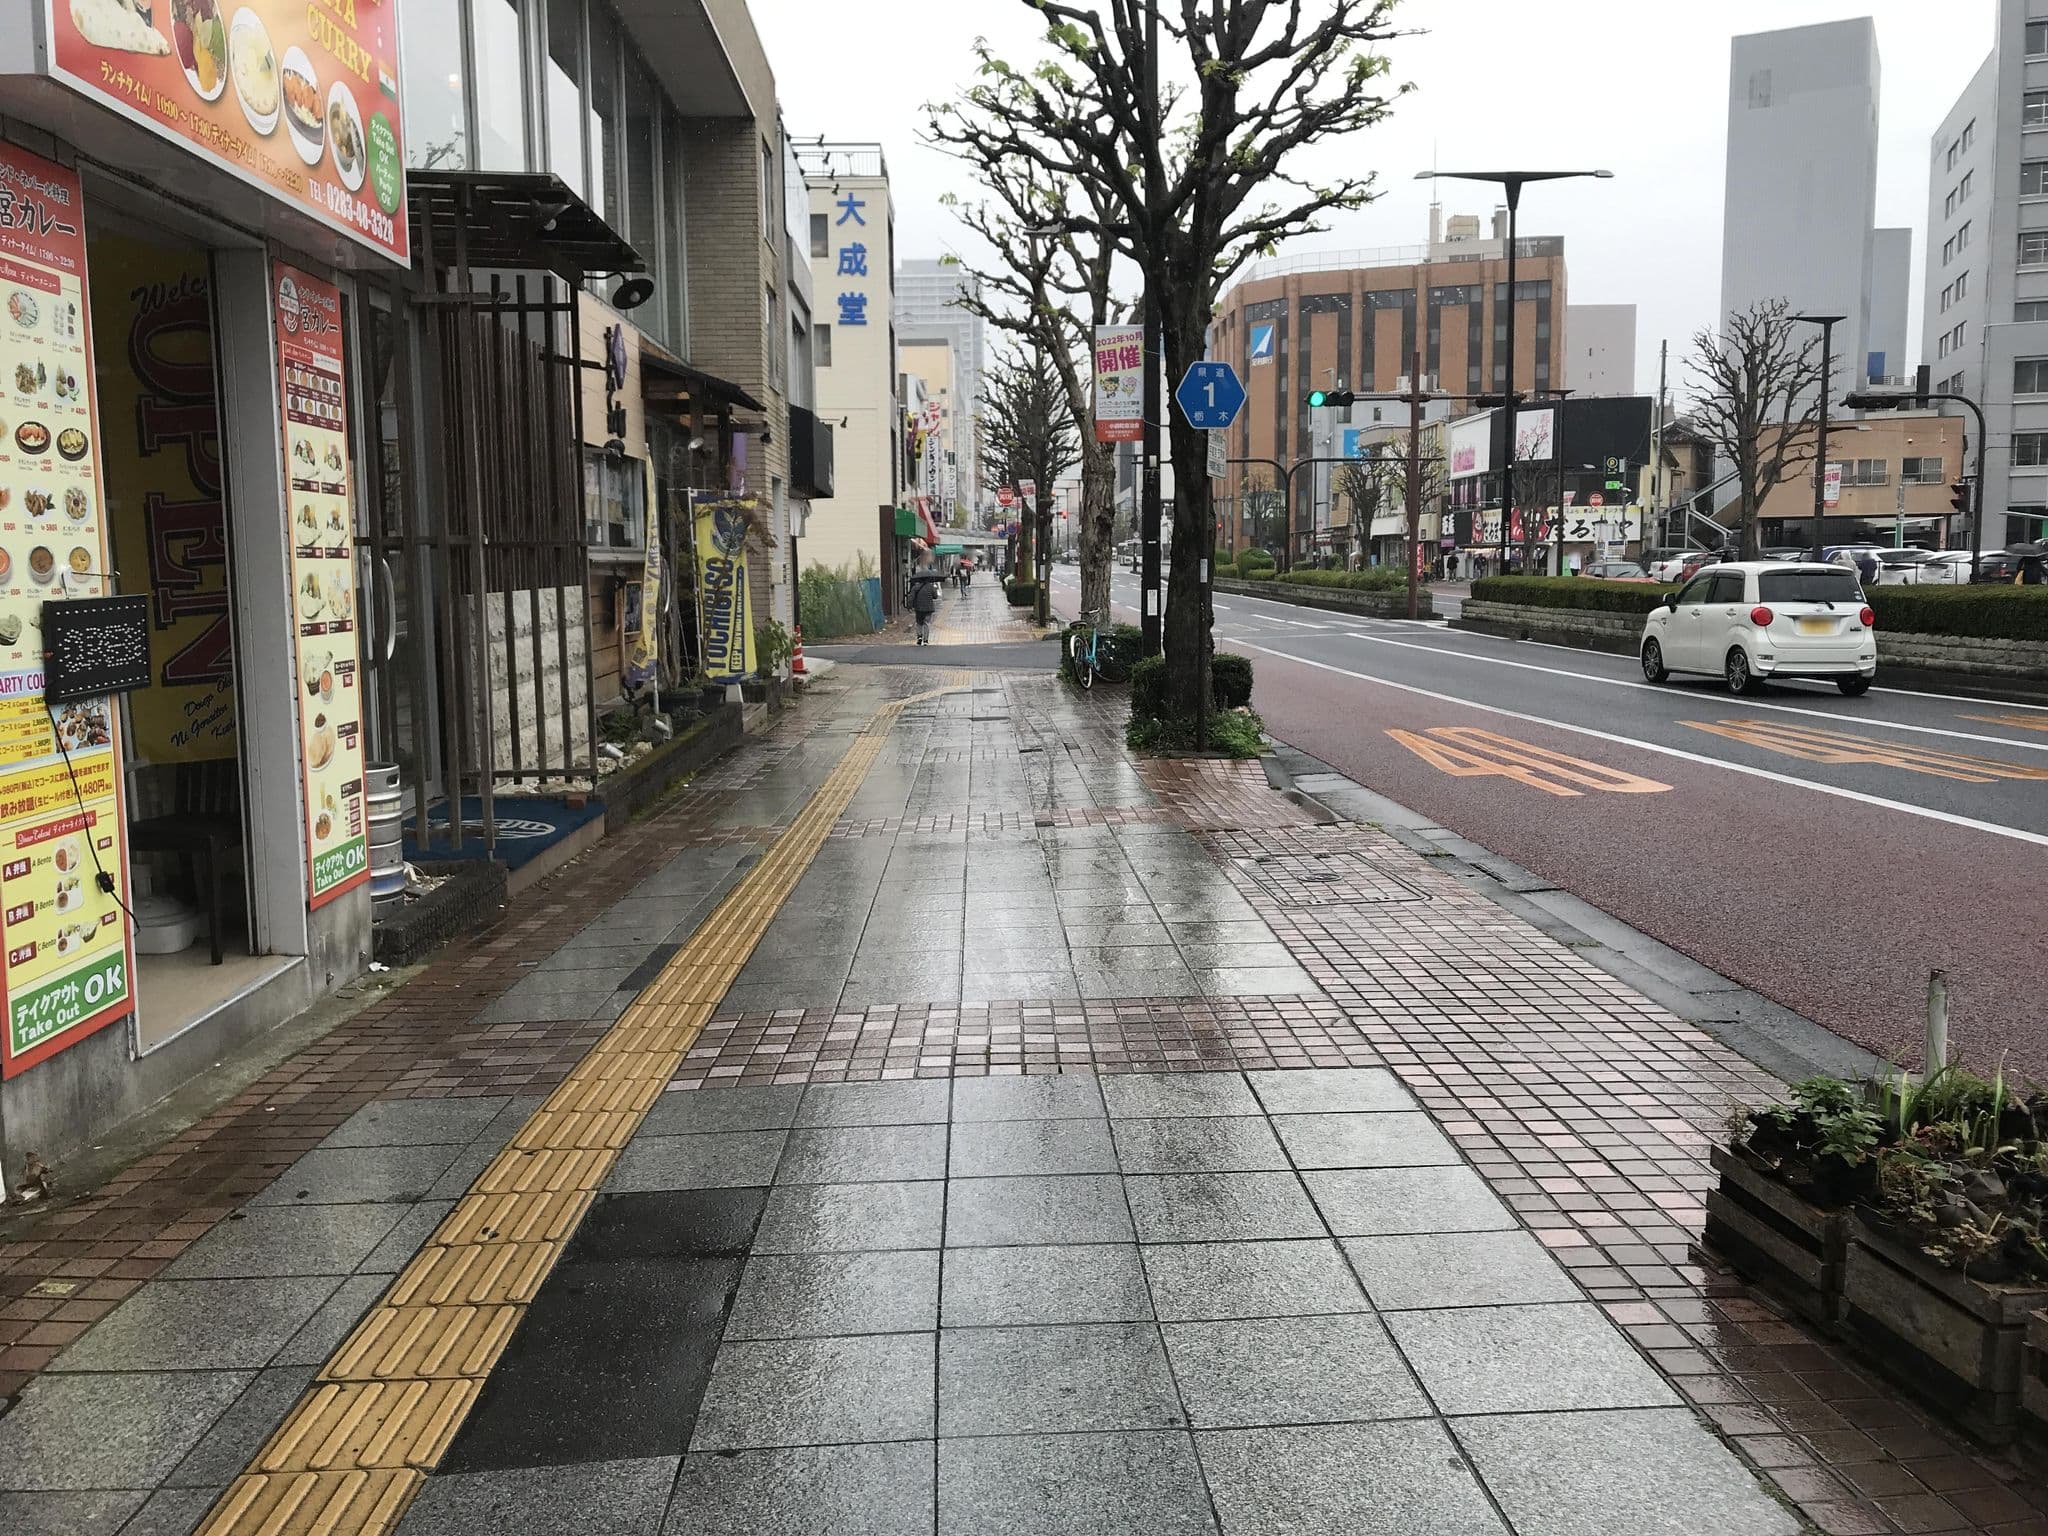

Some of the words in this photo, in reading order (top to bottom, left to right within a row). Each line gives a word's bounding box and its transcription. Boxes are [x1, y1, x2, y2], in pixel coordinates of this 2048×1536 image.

[307, 3, 372, 84] CURRY
[836, 192, 868, 326] 大成堂
[1097, 331, 1143, 346] 2022年10月
[1096, 345, 1141, 374] 開催
[1203, 382, 1215, 407] 1
[1194, 410, 1229, 422] 栃木
[1383, 727, 1673, 797] 40
[315, 850, 344, 877] テイクアウト
[346, 843, 365, 869] OK
[316, 873, 333, 889] Take
[333, 867, 345, 881] Out
[17, 981, 80, 1027] テイクアウト
[84, 964, 122, 1004] OK
[19, 1018, 53, 1044] Take
[56, 1003, 80, 1025] Out
